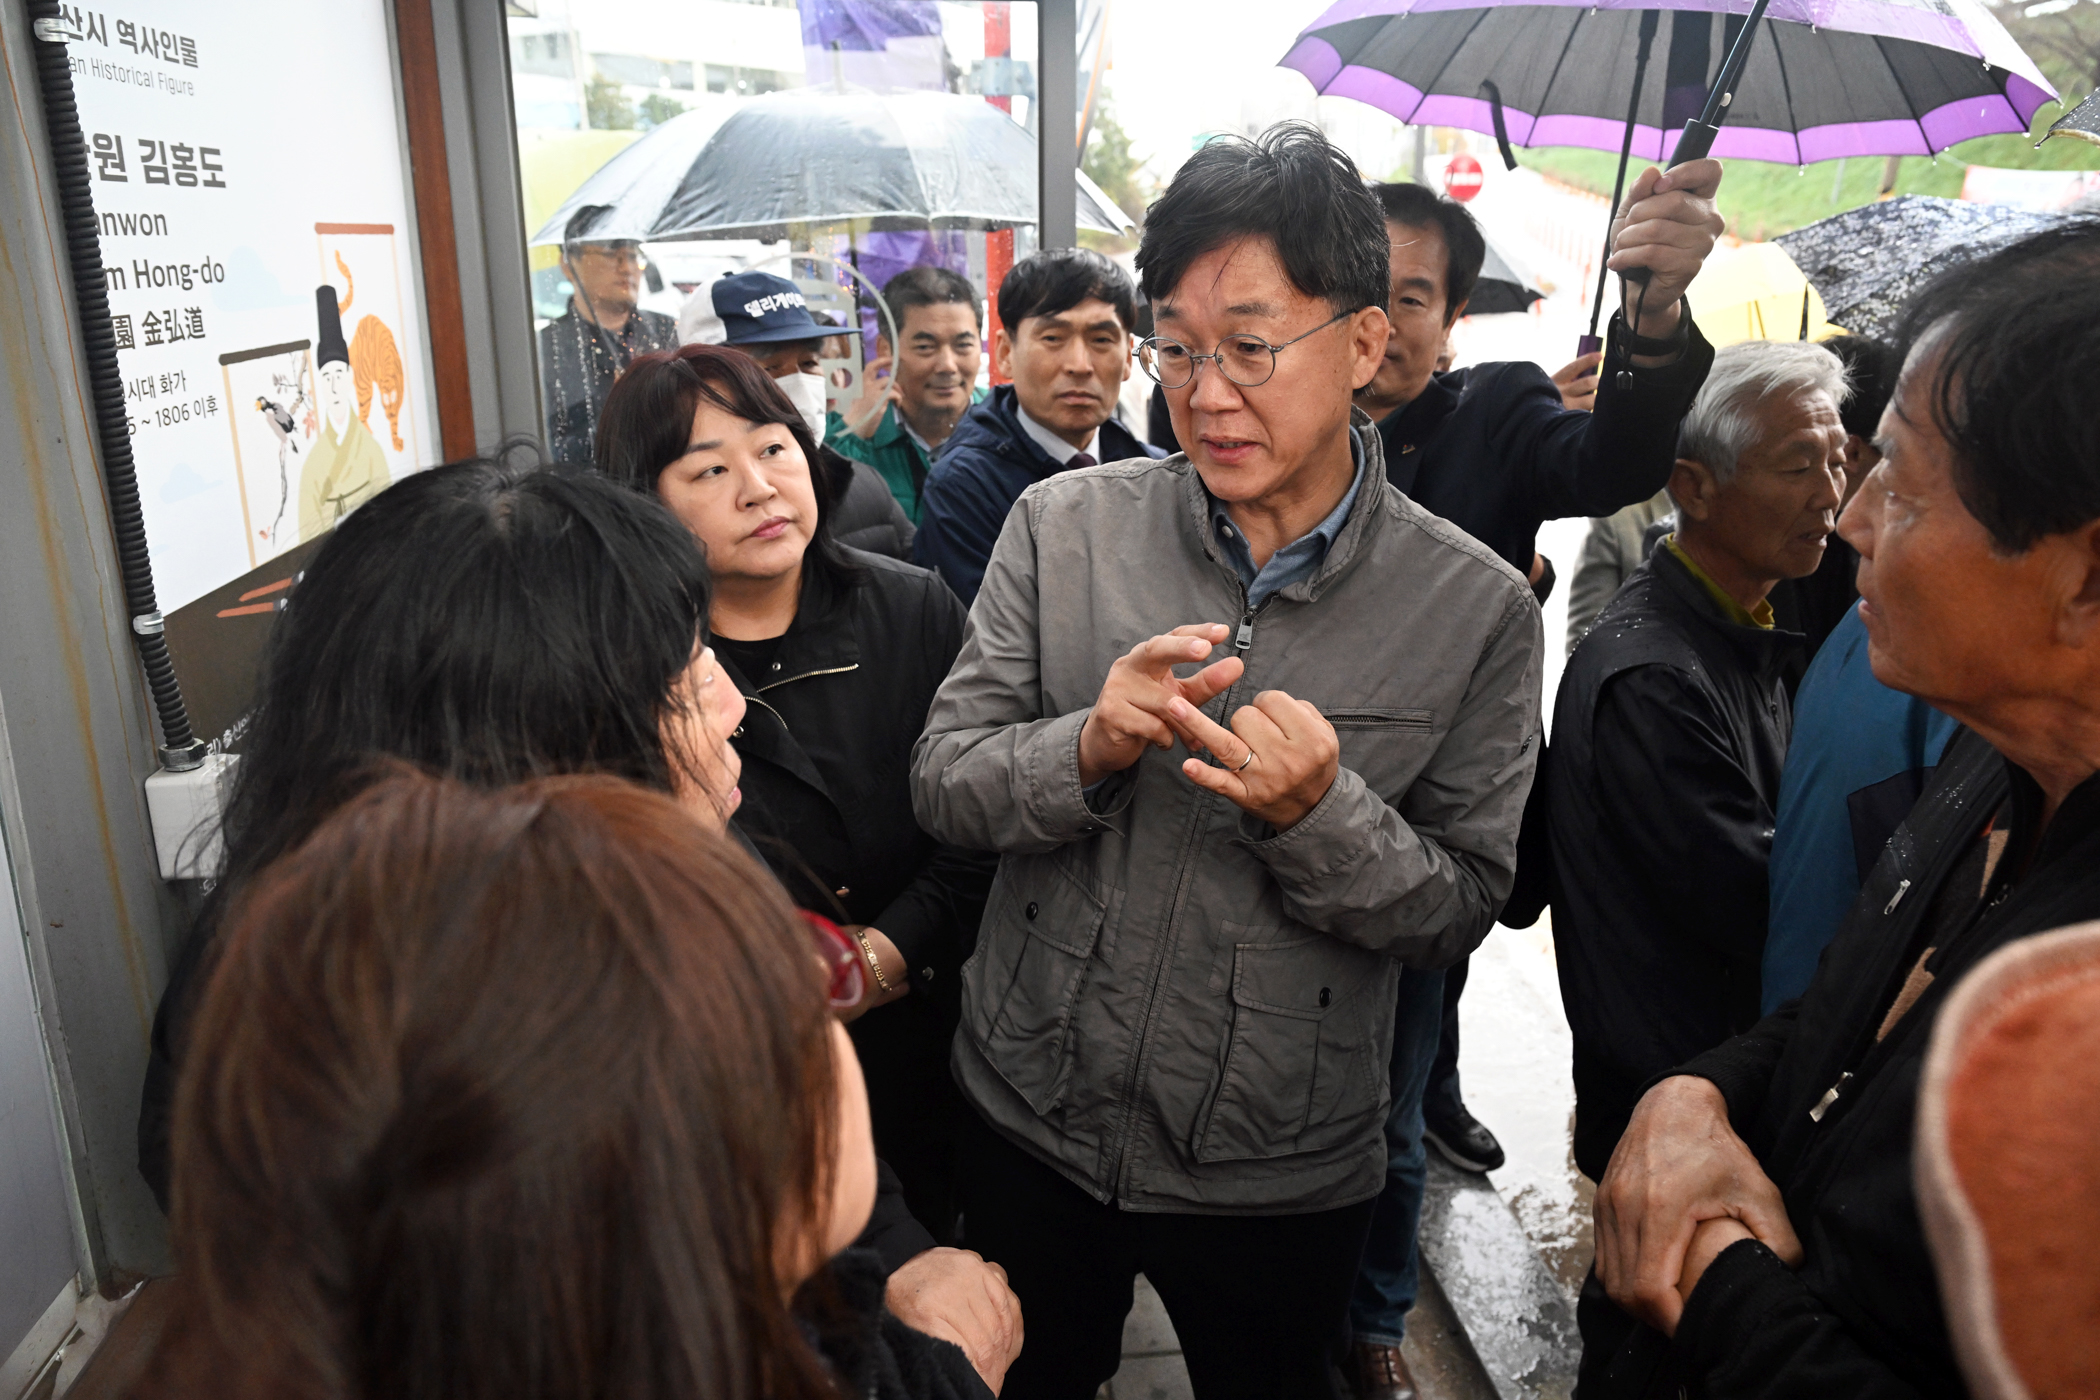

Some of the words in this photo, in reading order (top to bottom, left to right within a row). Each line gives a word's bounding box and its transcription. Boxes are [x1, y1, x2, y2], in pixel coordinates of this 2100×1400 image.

[116, 19, 199, 68] 역사인물
[90, 57, 155, 88] Historical
[157, 71, 195, 96] Figure
[80, 130, 128, 182] 원
[138, 138, 226, 188] 김홍도
[133, 255, 225, 291] Hong-do
[142, 306, 205, 346] 金弘道
[159, 369, 186, 395] 화가
[155, 403, 190, 428] 1806
[193, 395, 218, 419] 이후
